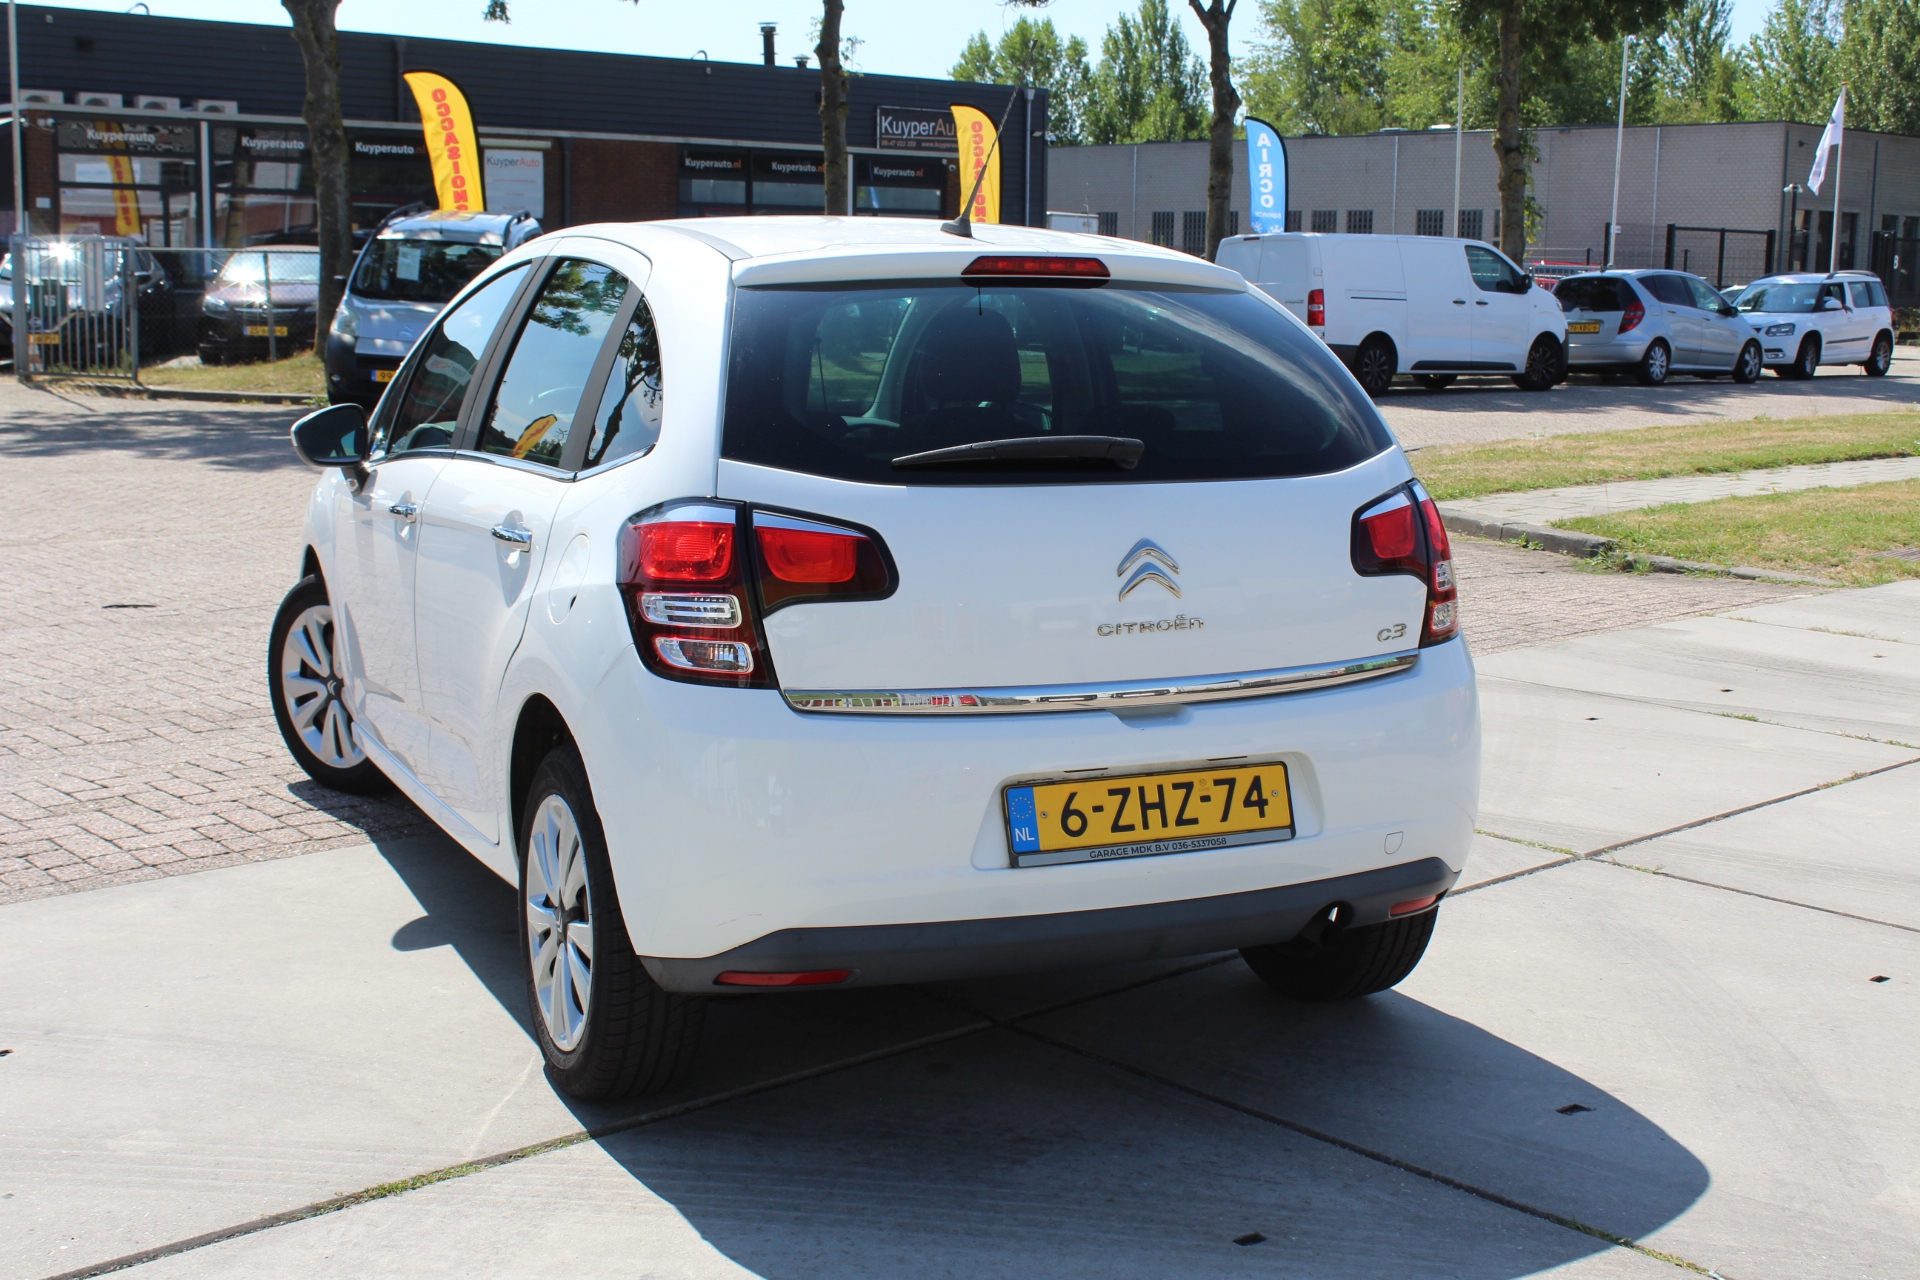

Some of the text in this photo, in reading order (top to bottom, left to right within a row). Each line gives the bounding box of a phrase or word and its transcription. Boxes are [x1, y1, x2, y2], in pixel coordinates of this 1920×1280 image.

[881, 115, 955, 139] KuyperAu
[86, 129, 169, 144] Kuyperauto
[241, 135, 306, 152] Kuyperauto
[486, 155, 541, 169] KuyperAuto
[685, 157, 742, 170] Kuyperauto.nl
[873, 166, 924, 178] Kuyperauto.nl
[1377, 623, 1407, 643] C3
[1059, 775, 1270, 838] 6-ZHZ-74
[1014, 827, 1036, 842] NL
[1089, 837, 1227, 859] GARAGE MDK B.V 036-5337058
